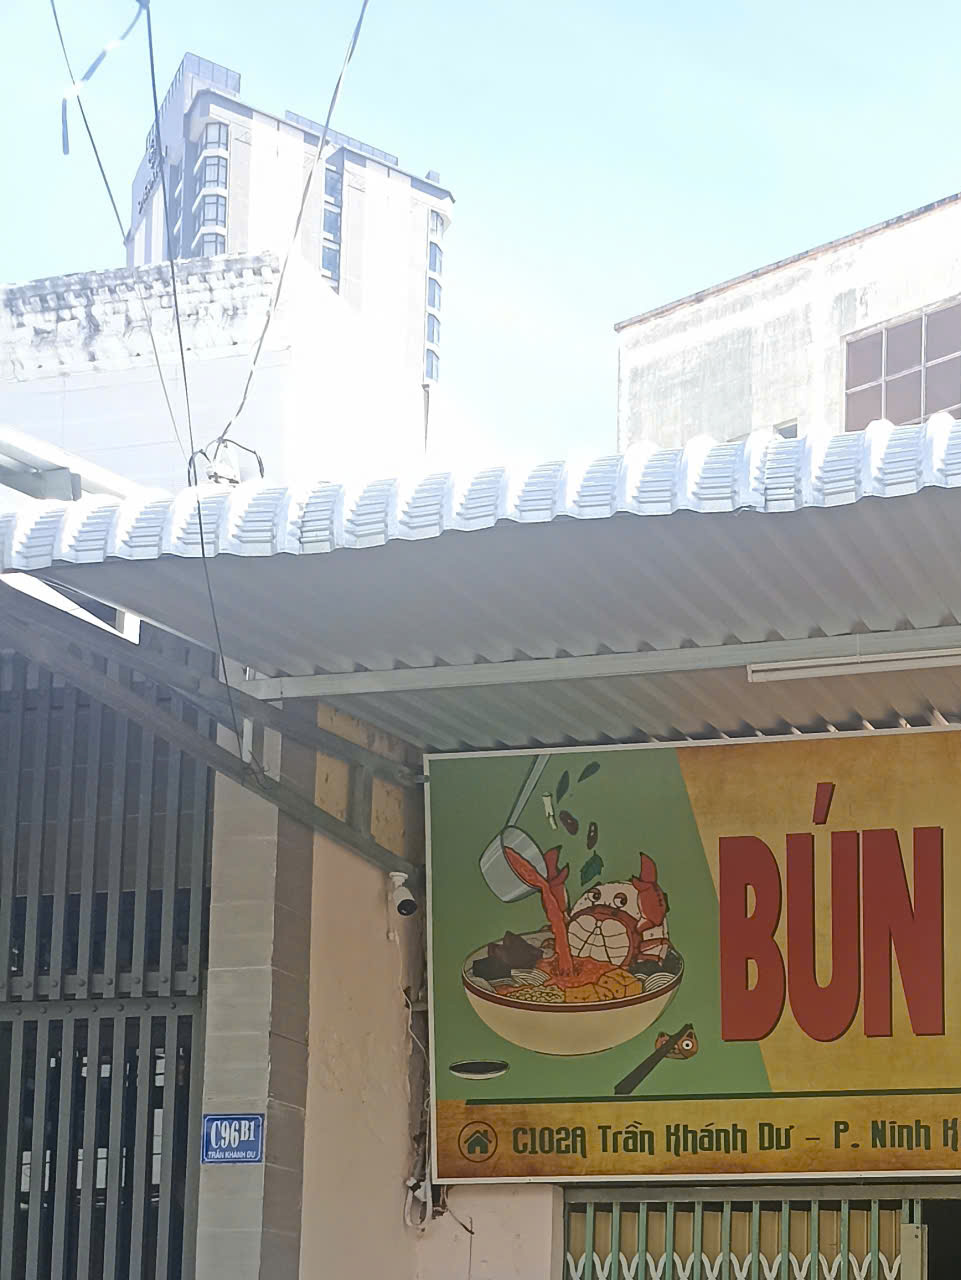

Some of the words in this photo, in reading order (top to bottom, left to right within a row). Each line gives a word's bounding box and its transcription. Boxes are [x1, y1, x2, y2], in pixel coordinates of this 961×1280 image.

[718, 782, 945, 1042] BÚN
[512, 1126, 587, 1158] C102A
[598, 1120, 655, 1155] Trần
[666, 1122, 748, 1157] Khánh
[758, 1122, 795, 1150] Dư
[834, 1120, 860, 1149] P.
[871, 1119, 931, 1151] Ninh
